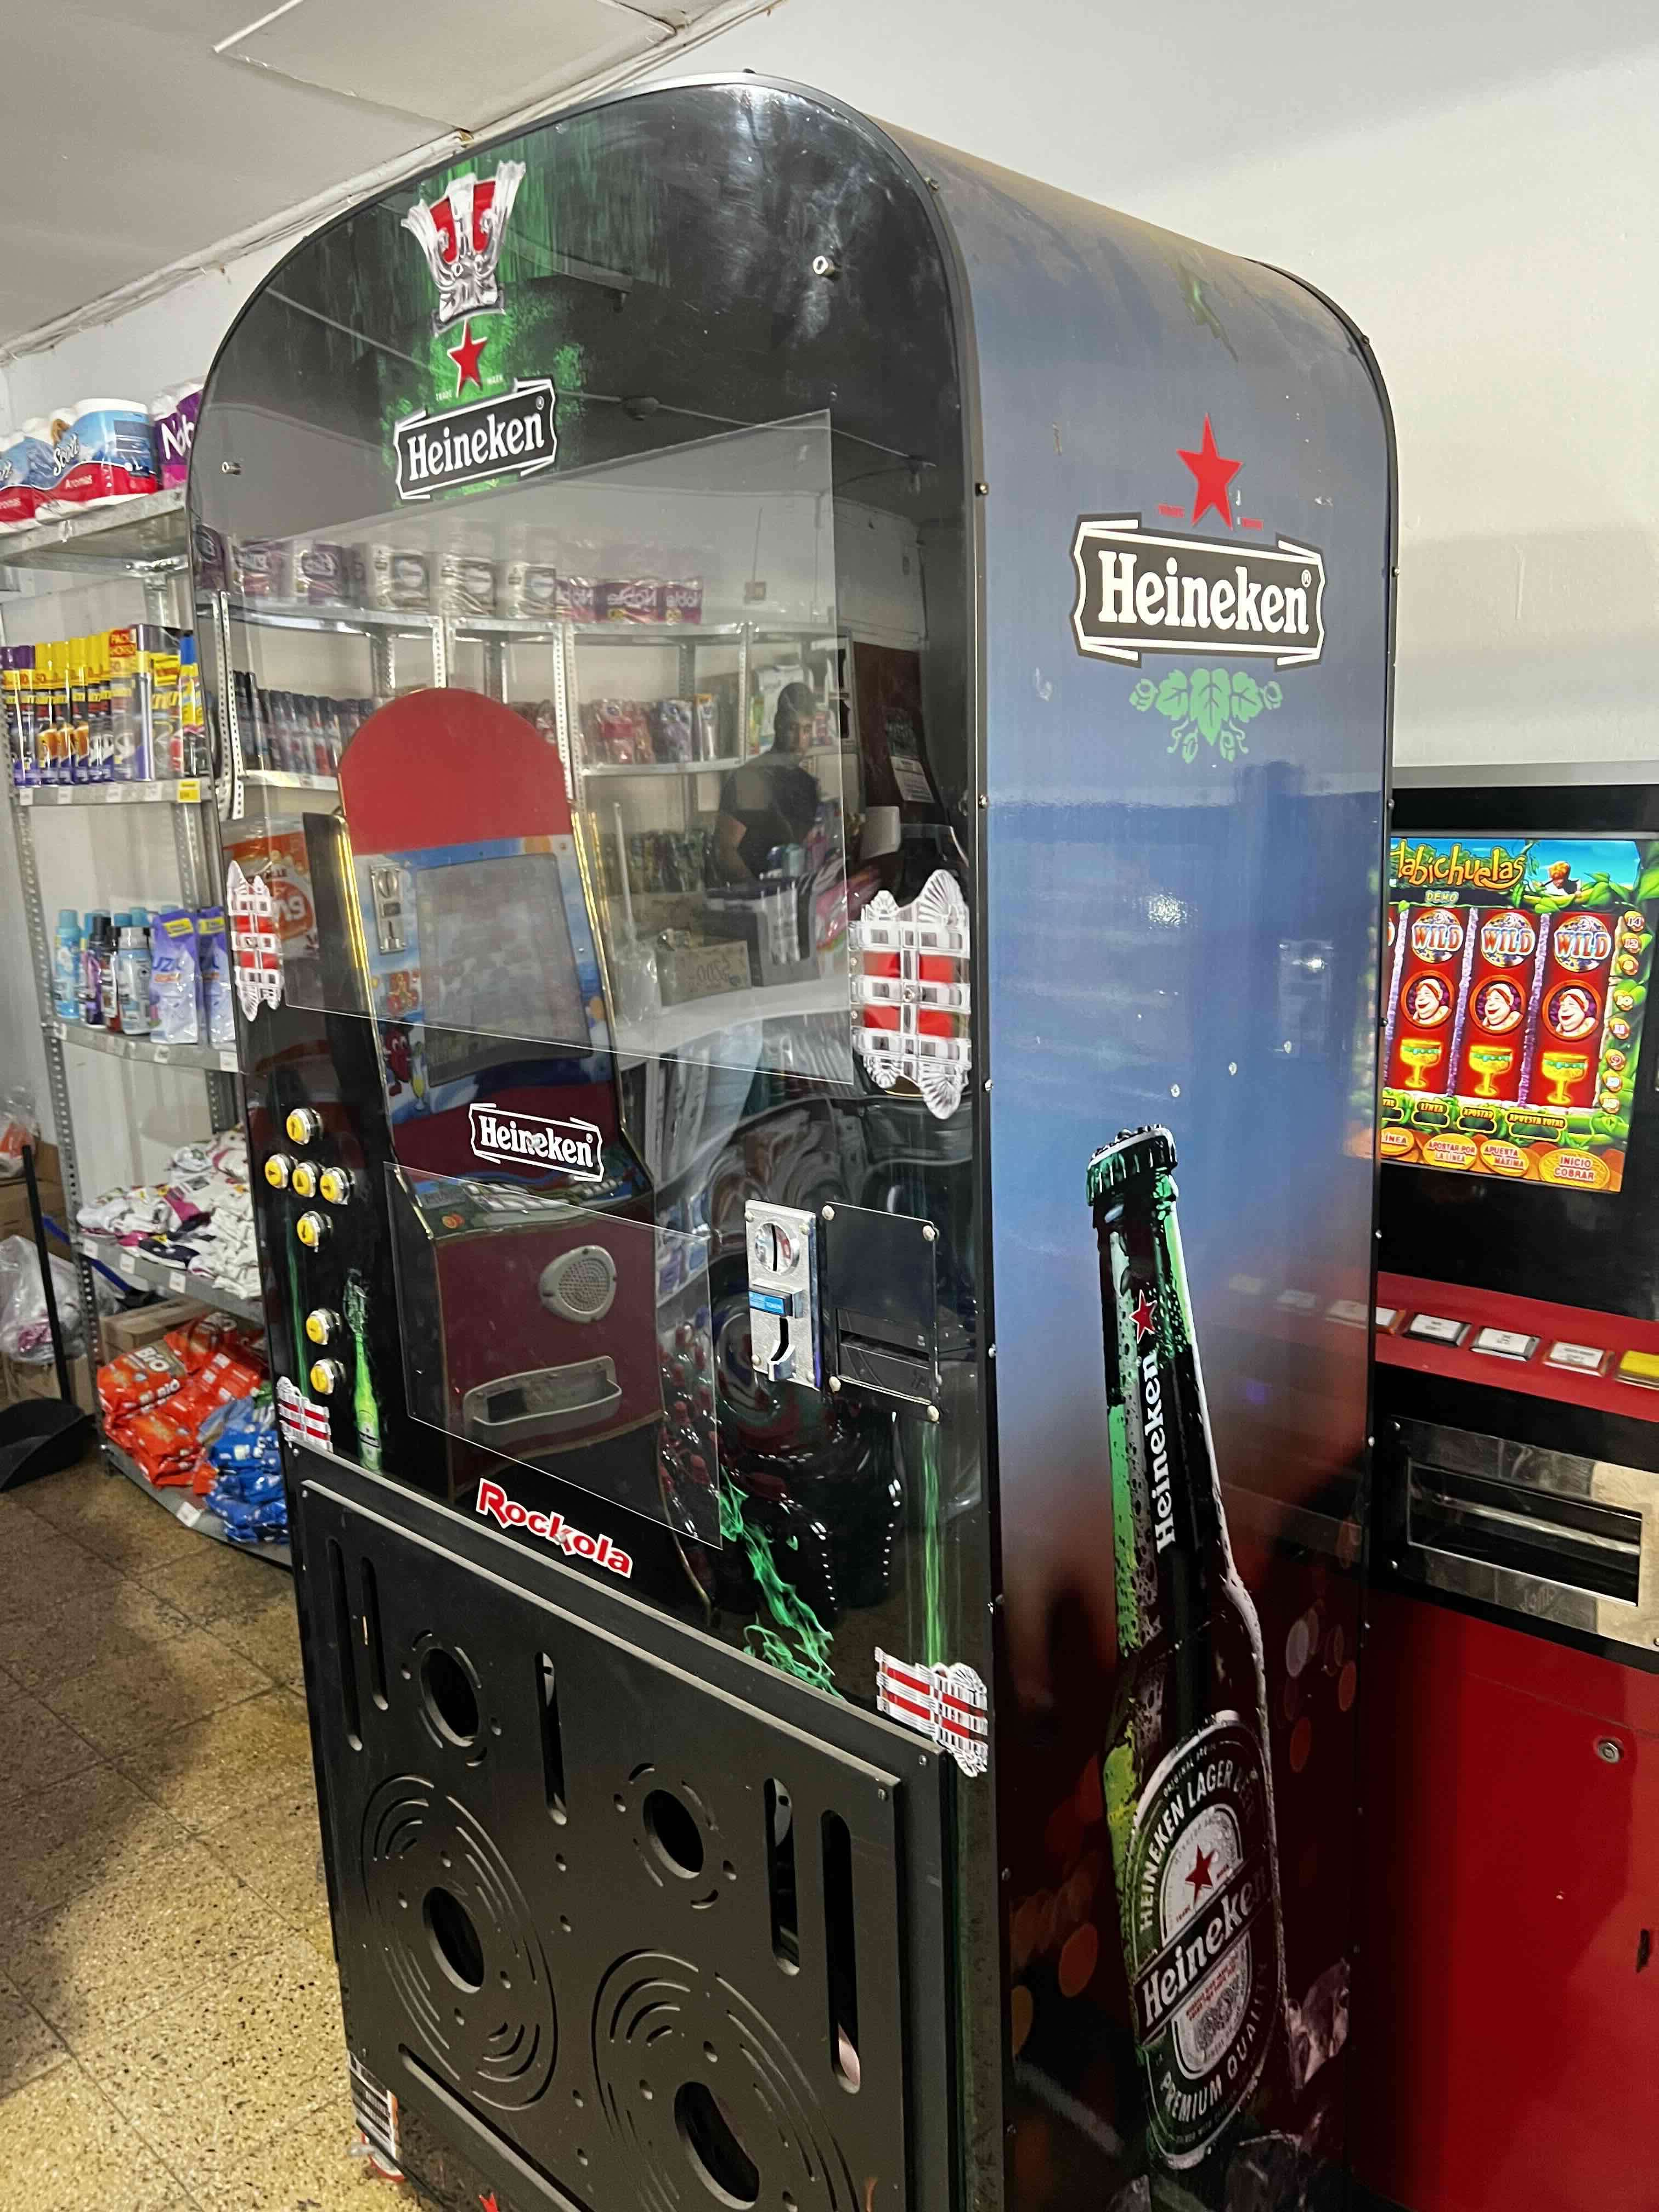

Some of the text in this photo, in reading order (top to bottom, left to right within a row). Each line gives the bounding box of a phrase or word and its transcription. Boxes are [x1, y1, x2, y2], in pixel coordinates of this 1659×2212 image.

[407, 413, 545, 481] Heineken
[1098, 550, 1310, 635] Heineken
[1425, 890, 1458, 904] DEMO
[1413, 924, 1463, 951] WILD
[1482, 927, 1534, 954] WILD
[1555, 932, 1611, 960] WILD
[1554, 1166, 1595, 1181] COBRAR
[1560, 1156, 1592, 1169] INICIO
[1143, 1348, 1176, 1554] Heineken
[476, 1479, 633, 1578] Rockola
[1140, 1794, 1186, 1932] HEINEKEN
[1187, 1759, 1233, 1809] LAGER
[1160, 2070, 1223, 2123] PREMIUM
